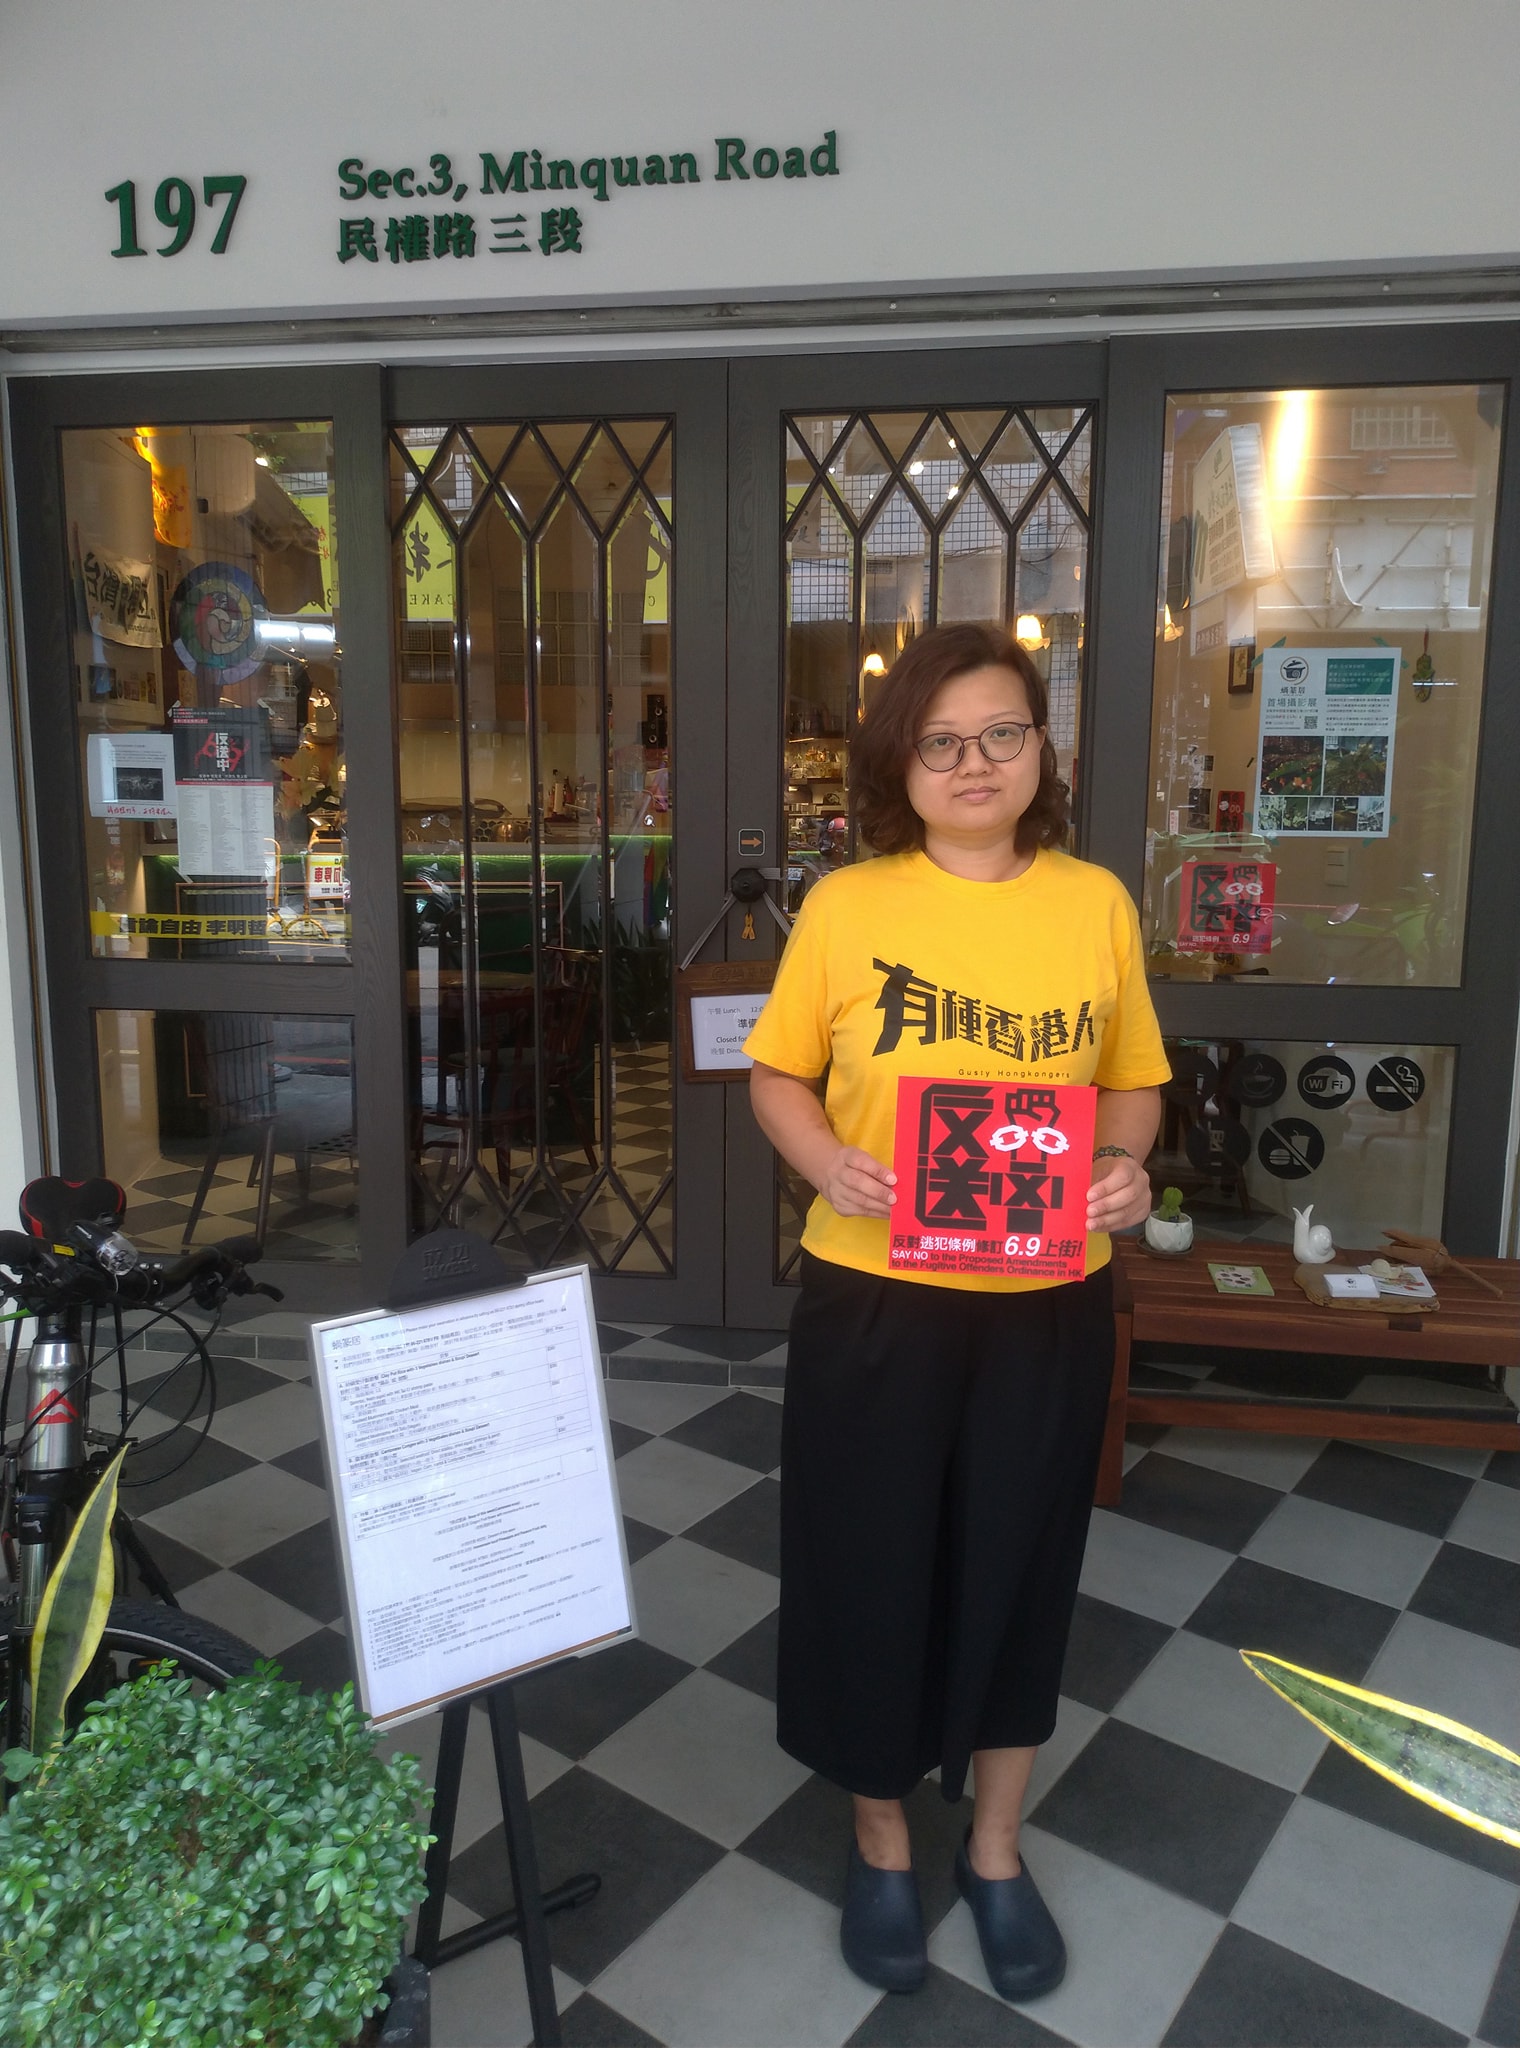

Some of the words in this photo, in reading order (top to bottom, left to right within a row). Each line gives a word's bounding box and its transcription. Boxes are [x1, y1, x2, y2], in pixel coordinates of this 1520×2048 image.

[339, 153, 469, 204] Sec.3,
[479, 147, 702, 203] Minquan
[714, 129, 841, 180] Road
[104, 174, 249, 260] 197
[215, 732, 230, 772] 反送中
[1232, 933, 1250, 944] 6.9
[723, 1006, 741, 1014] Lunch
[871, 957, 1095, 1063] 有種香港人
[958, 1067, 991, 1078] Gusty
[998, 1069, 1071, 1080] Hongkongers
[1004, 1236, 1041, 1257] 6.9
[891, 1249, 910, 1259] SAY
[913, 1250, 929, 1260] NO
[930, 1252, 940, 1261] to
[942, 1252, 956, 1262] the
[958, 1253, 1004, 1266] Proposed
[1005, 1255, 1067, 1268] Amendments
[891, 1259, 901, 1268] to
[903, 1259, 917, 1269] the
[919, 1260, 957, 1273] Fugitive
[958, 1262, 1005, 1274] Offenders
[1007, 1265, 1056, 1277] Ordinance
[1057, 1267, 1066, 1277] in
[1068, 1268, 1083, 1278] HK
